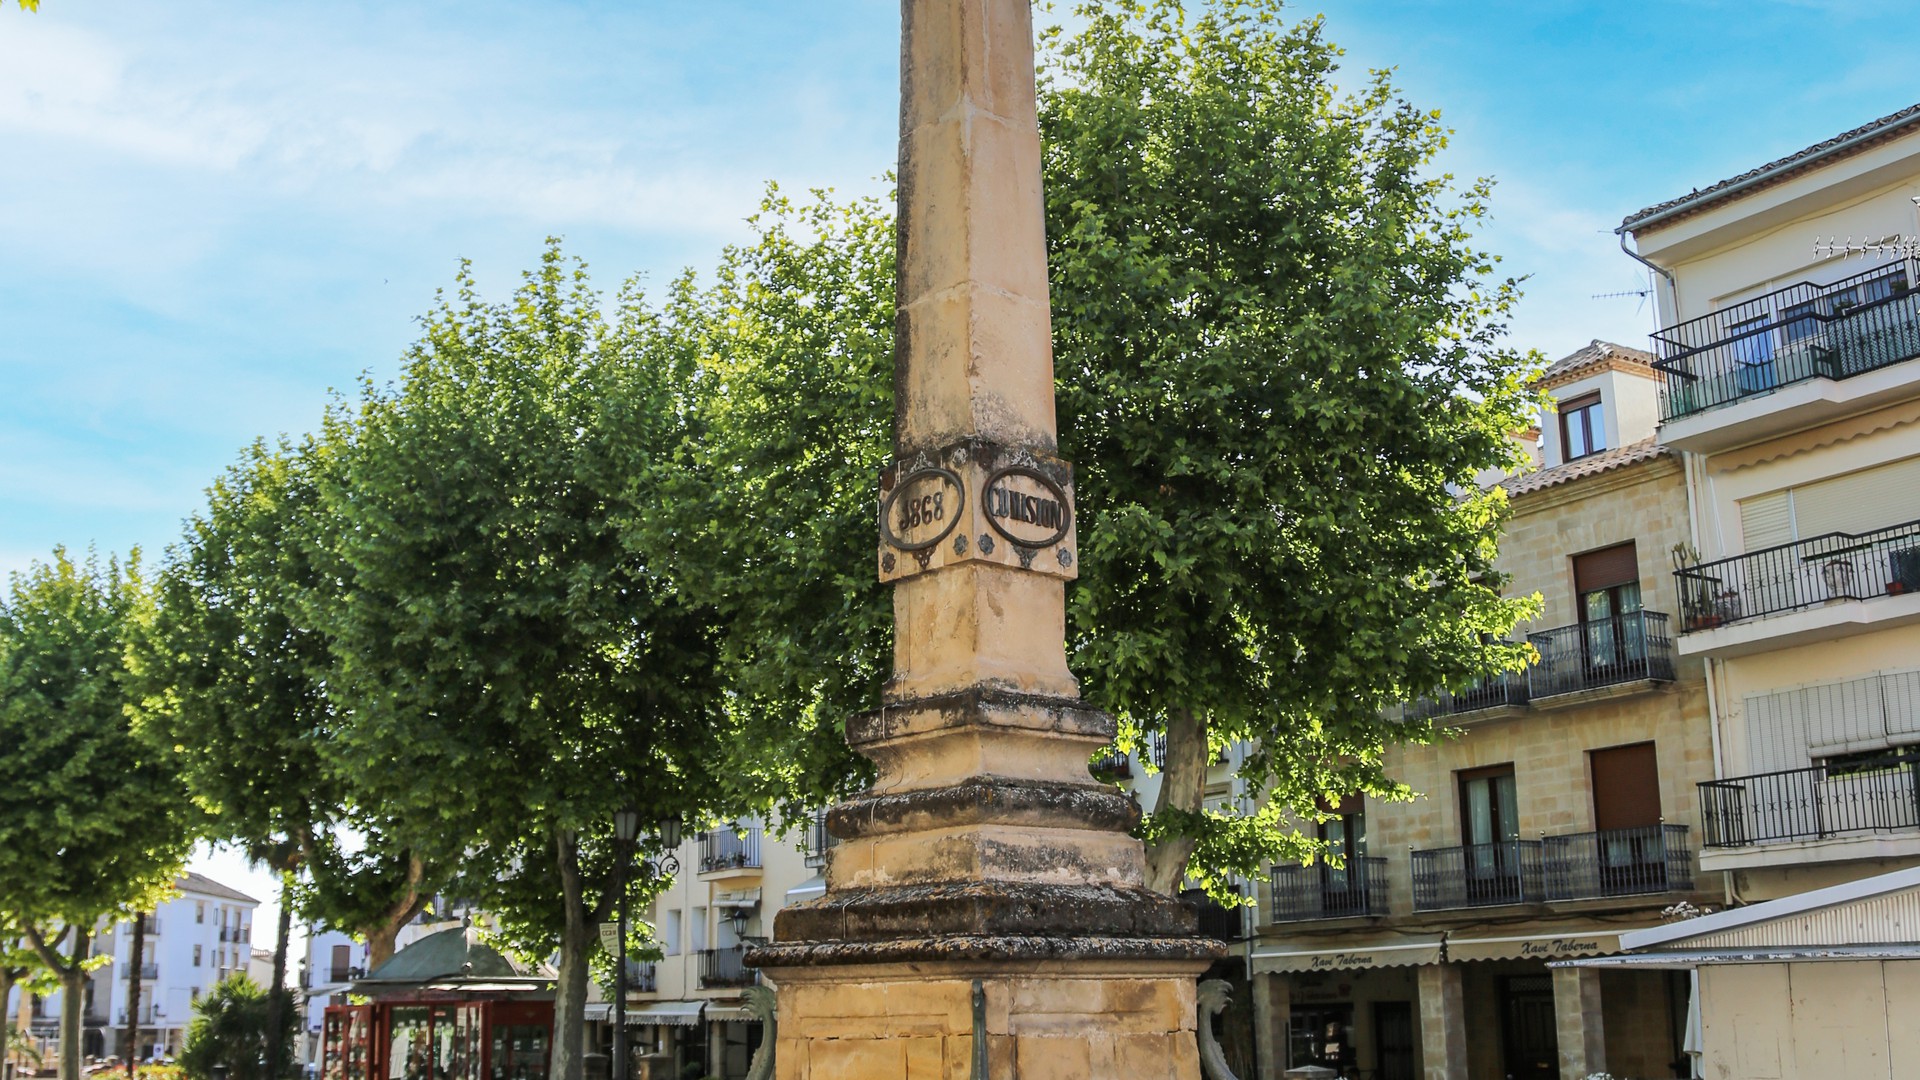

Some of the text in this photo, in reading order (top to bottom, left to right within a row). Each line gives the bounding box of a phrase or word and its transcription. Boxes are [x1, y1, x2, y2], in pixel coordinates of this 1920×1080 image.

[1521, 938, 1598, 954] Xavi Taberna
[1311, 952, 1373, 967] Xavi Taberna
